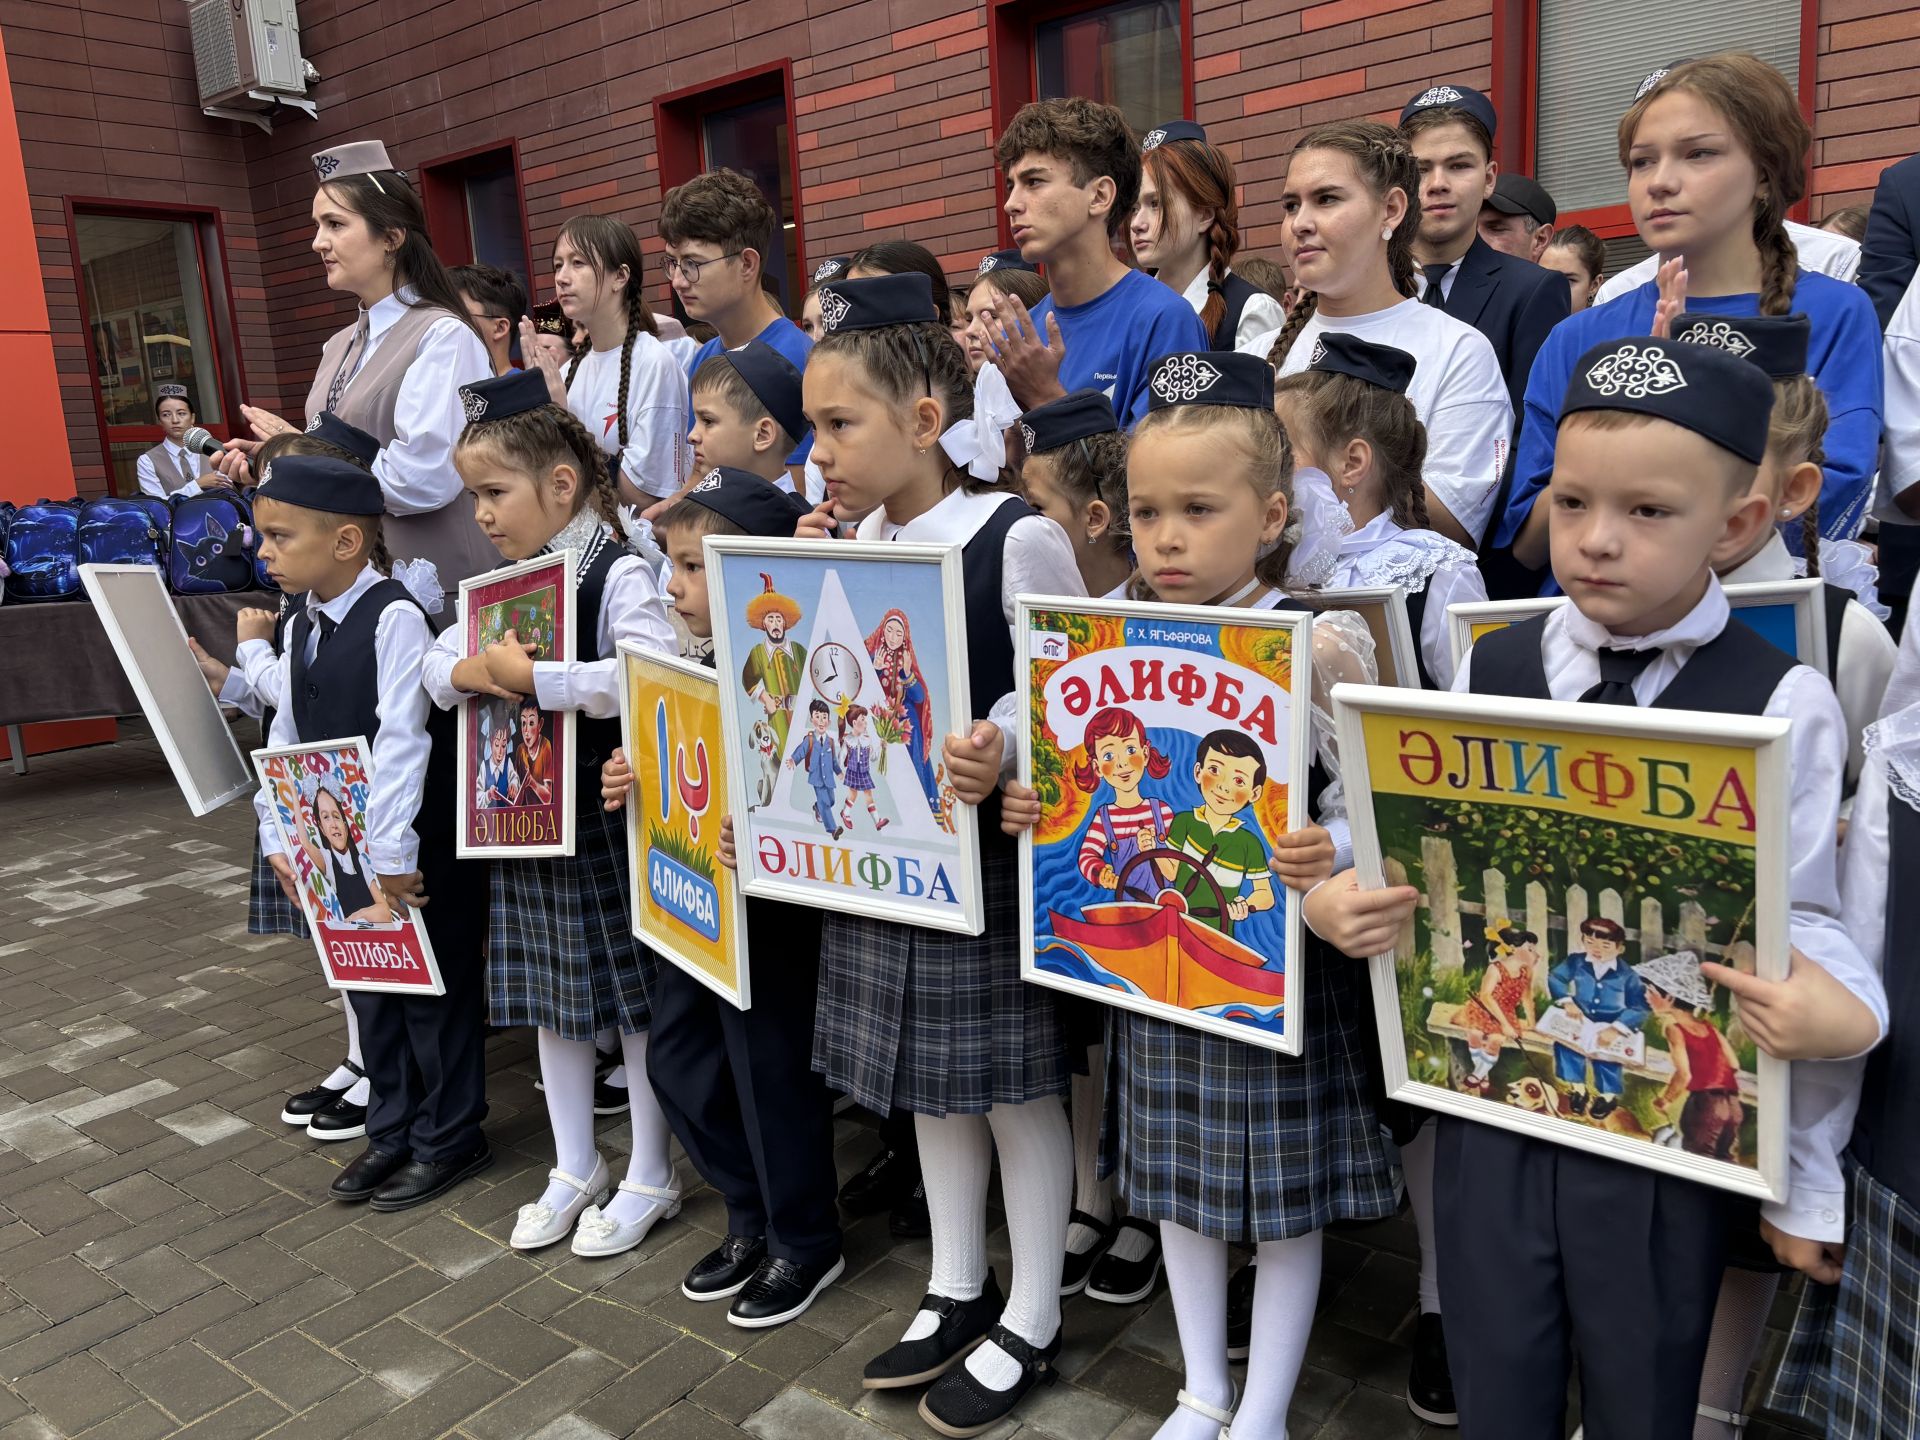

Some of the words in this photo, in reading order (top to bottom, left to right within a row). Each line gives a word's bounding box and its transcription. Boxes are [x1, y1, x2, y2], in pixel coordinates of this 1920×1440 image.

[829, 647, 839, 656] 12
[814, 669, 820, 678] 9
[853, 671, 859, 680] 3
[1061, 659, 1278, 745] ӘЛИФБА
[1399, 730, 1756, 832] ӘЛИФБА
[475, 810, 558, 843] ӘЛИФБА
[758, 833, 960, 904] ӘЛИФБА
[653, 861, 716, 929] АЛИФБА
[330, 940, 420, 970] ӘЛИФБА
